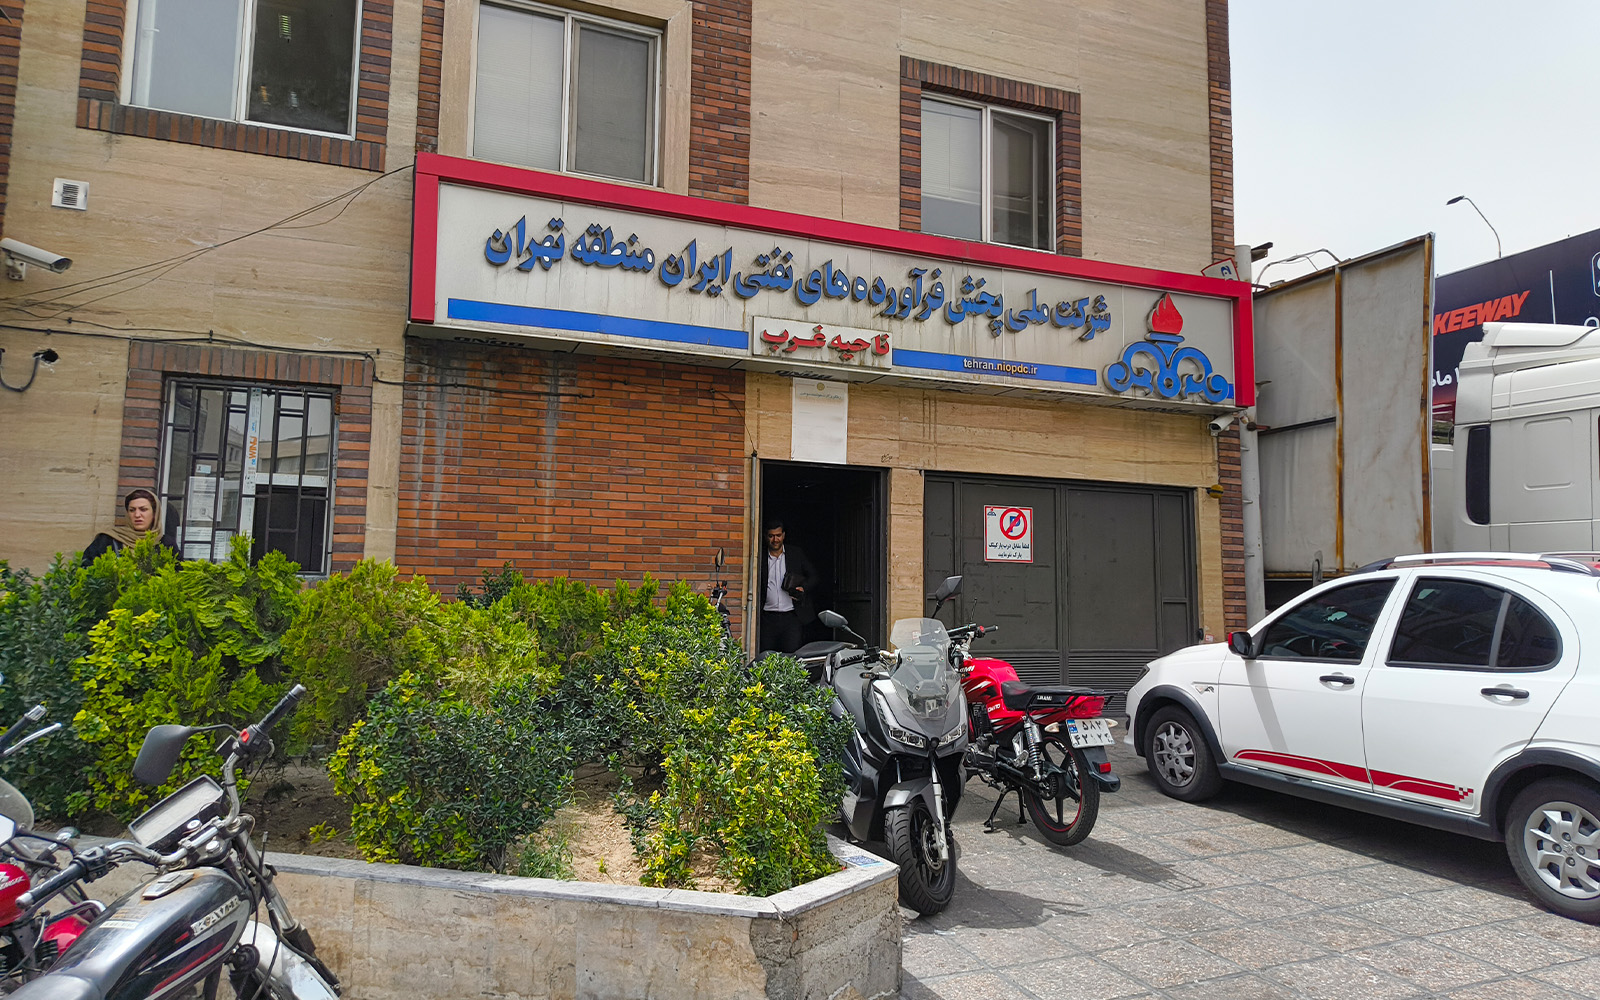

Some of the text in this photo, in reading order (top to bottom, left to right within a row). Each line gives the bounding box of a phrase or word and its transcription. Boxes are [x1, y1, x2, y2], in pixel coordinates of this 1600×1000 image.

[485, 214, 565, 272] تهران
[571, 223, 655, 273] منطقه
[659, 238, 734, 297] ایران
[733, 246, 793, 299] نفتی
[944, 275, 1004, 337] پخش
[1004, 287, 1049, 332] ملی
[1051, 294, 1112, 341] شرکت
[1433, 290, 1530, 336] KEEWAY
[760, 324, 890, 361] ناحیه غرب
[963, 358, 1038, 375] tehran.niopdc.ir
